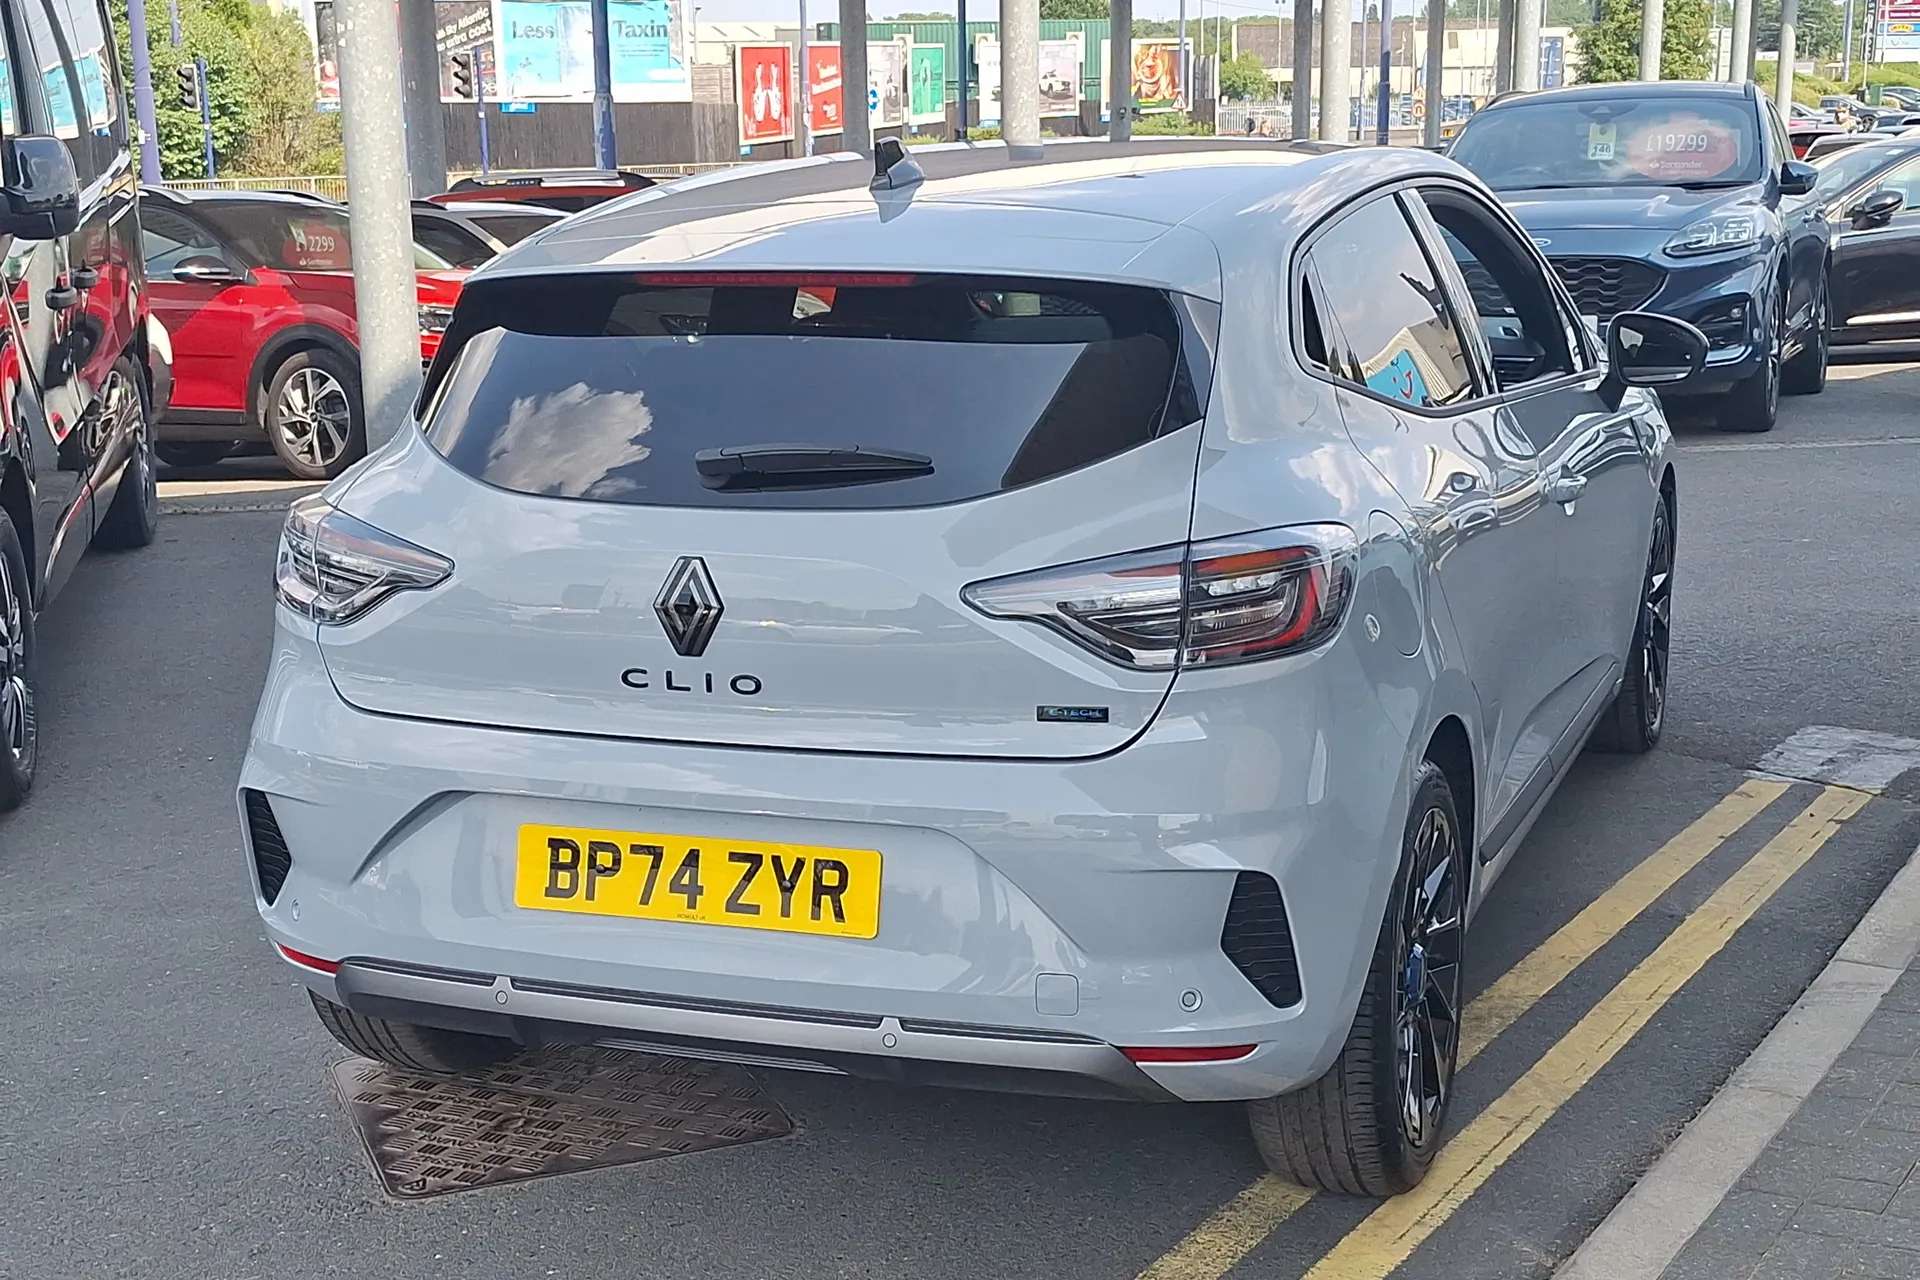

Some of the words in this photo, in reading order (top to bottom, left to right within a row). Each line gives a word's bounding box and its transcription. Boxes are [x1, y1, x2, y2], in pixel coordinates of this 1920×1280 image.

[512, 21, 555, 39] Less
[1646, 133, 1708, 152] £19299
[620, 667, 763, 696] CLIO
[544, 836, 704, 911] BP74
[725, 851, 849, 923] ZYR
